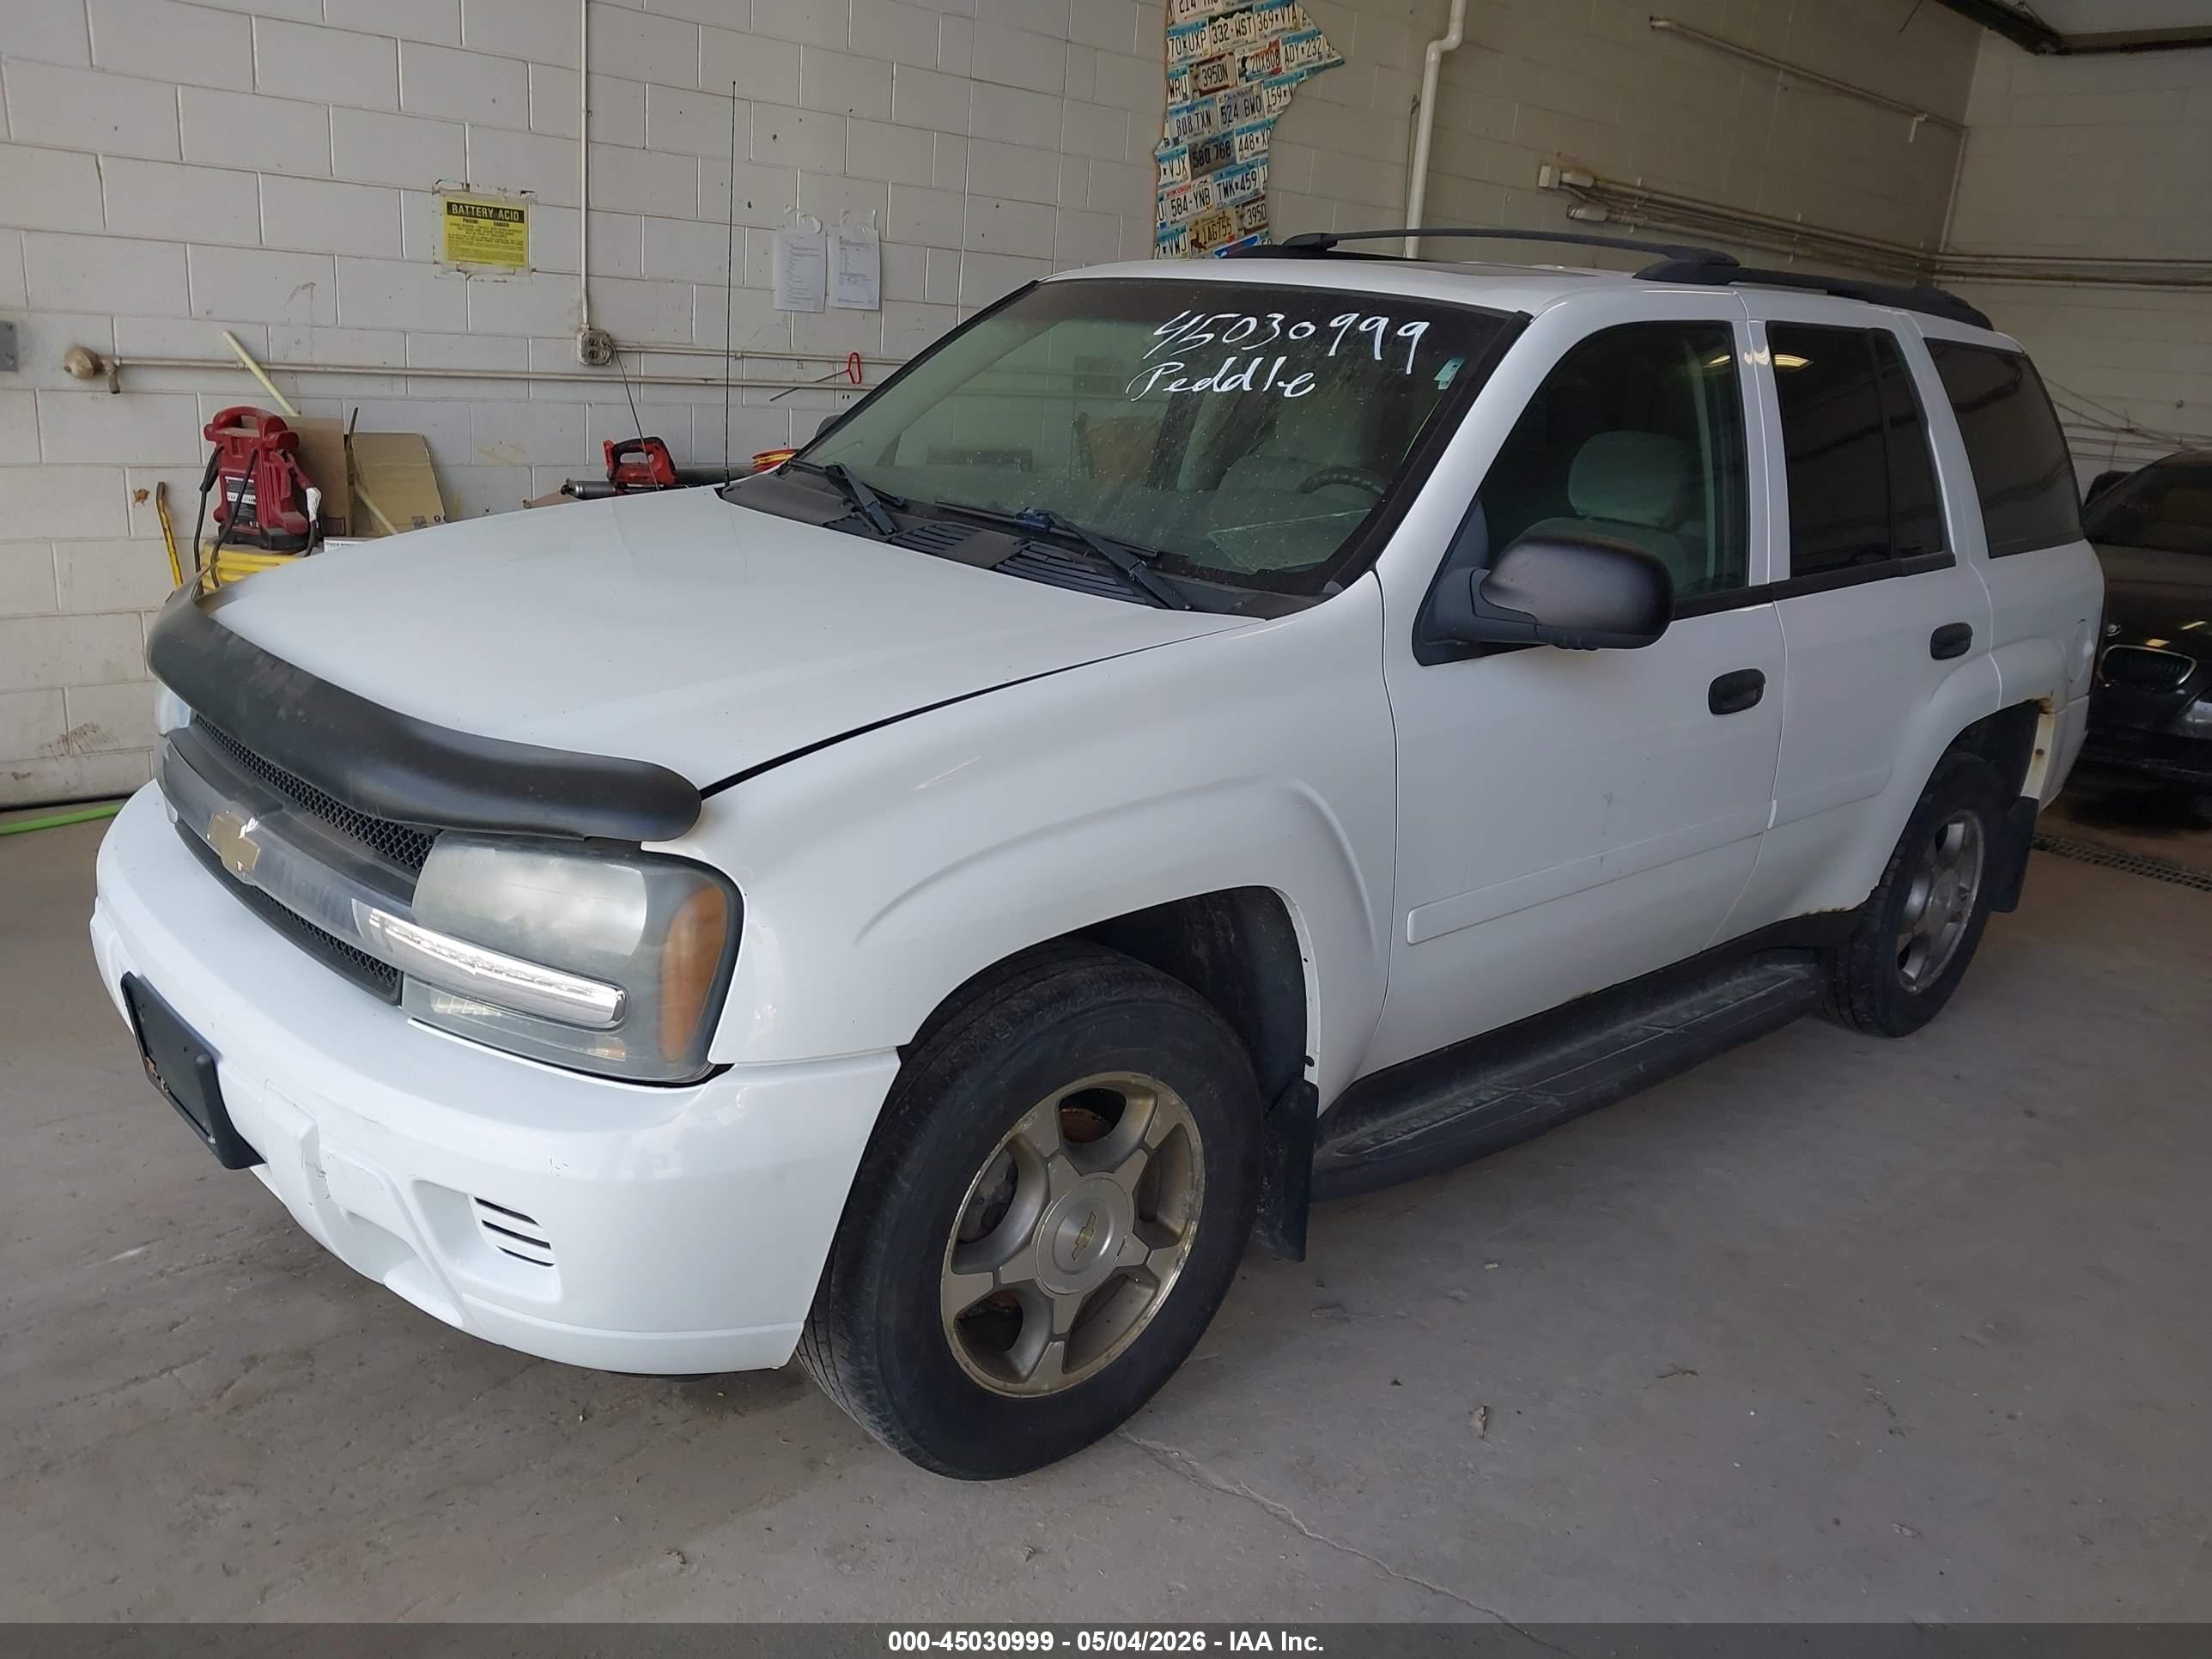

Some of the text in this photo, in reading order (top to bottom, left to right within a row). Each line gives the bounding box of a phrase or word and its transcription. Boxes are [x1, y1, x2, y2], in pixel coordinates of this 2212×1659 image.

[1257, 9, 1273, 32] 369
[1188, 29, 1206, 52] UXP
[1306, 37, 1322, 58] 232
[1266, 86, 1282, 108] 159
[1176, 109, 1212, 137] 808 TXN
[1220, 102, 1239, 125] 524
[1213, 141, 1231, 160] 768
[1238, 133, 1255, 154] 448
[1169, 155, 1188, 179] VJX
[1217, 170, 1257, 201] TWK 459
[452, 204, 520, 222] BATTERY ACID
[1126, 356, 1316, 402] Peddle
